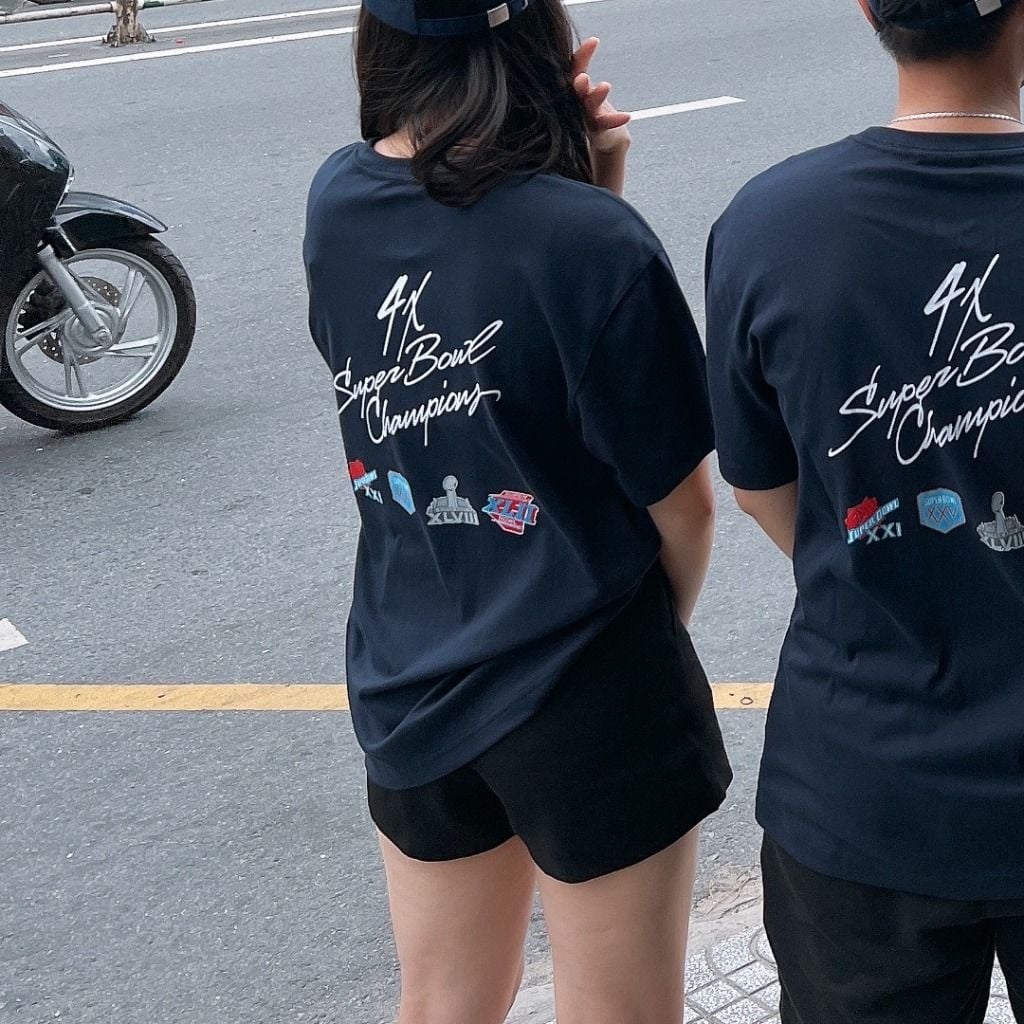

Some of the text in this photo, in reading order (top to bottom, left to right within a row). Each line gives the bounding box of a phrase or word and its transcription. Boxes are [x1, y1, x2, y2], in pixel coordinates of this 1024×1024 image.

[334, 319, 504, 419] Super Bowl
[366, 379, 501, 447] Champions
[828, 364, 958, 458] Super
